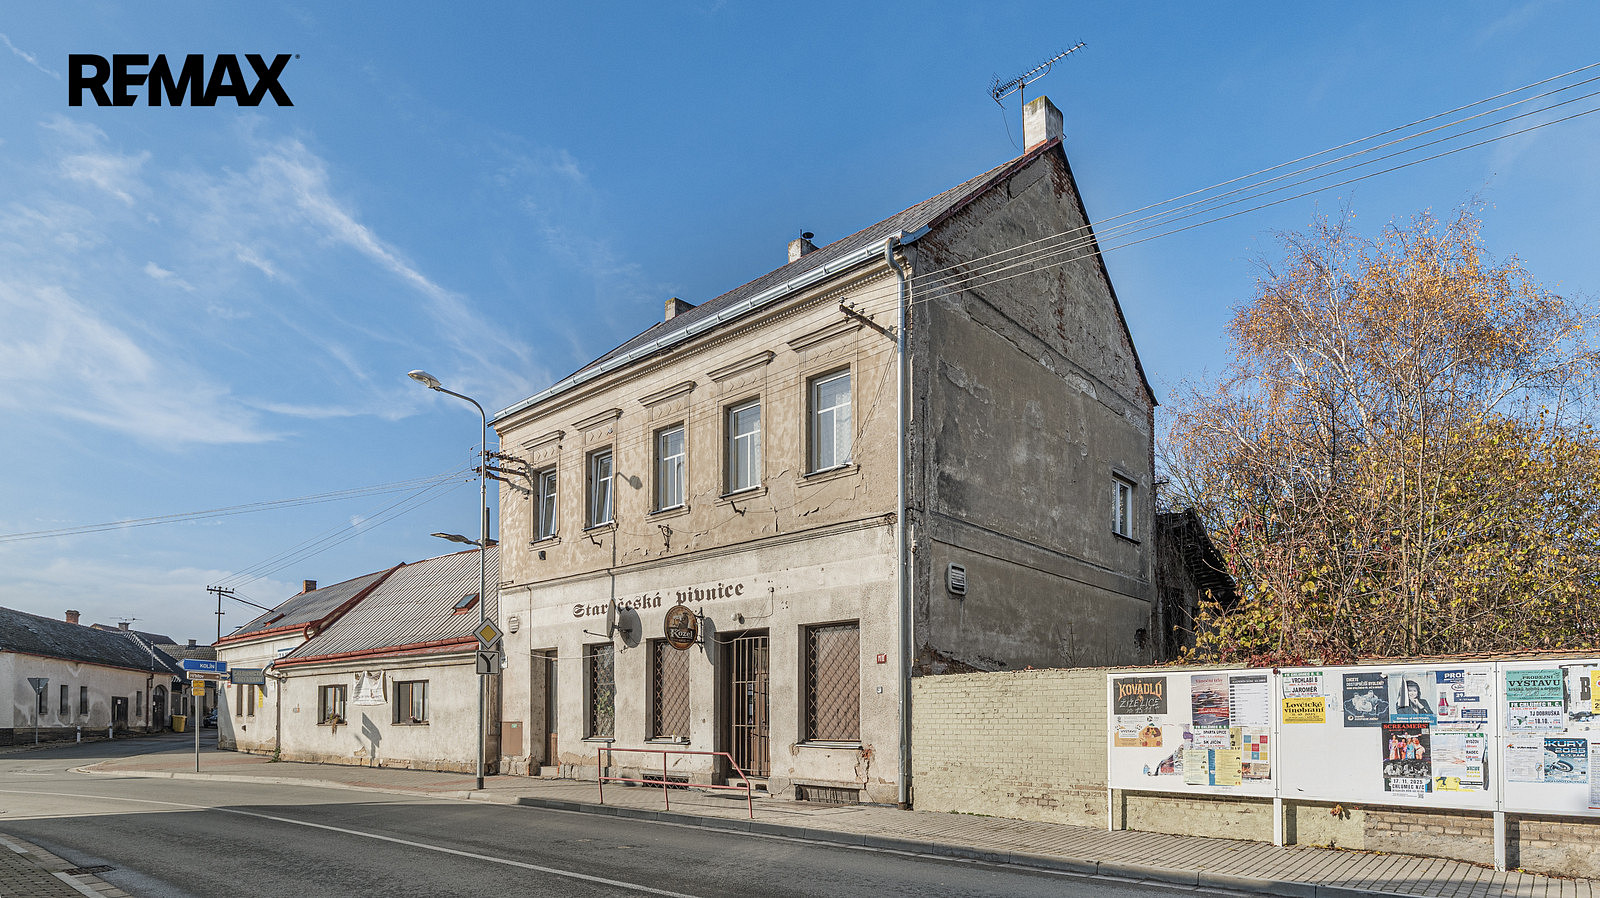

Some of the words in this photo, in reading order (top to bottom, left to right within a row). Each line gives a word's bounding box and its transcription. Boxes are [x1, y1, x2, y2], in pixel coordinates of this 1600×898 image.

[573, 593, 662, 617] Starčeská
[675, 582, 745, 606] pivnice
[670, 629, 692, 638] Kozel
